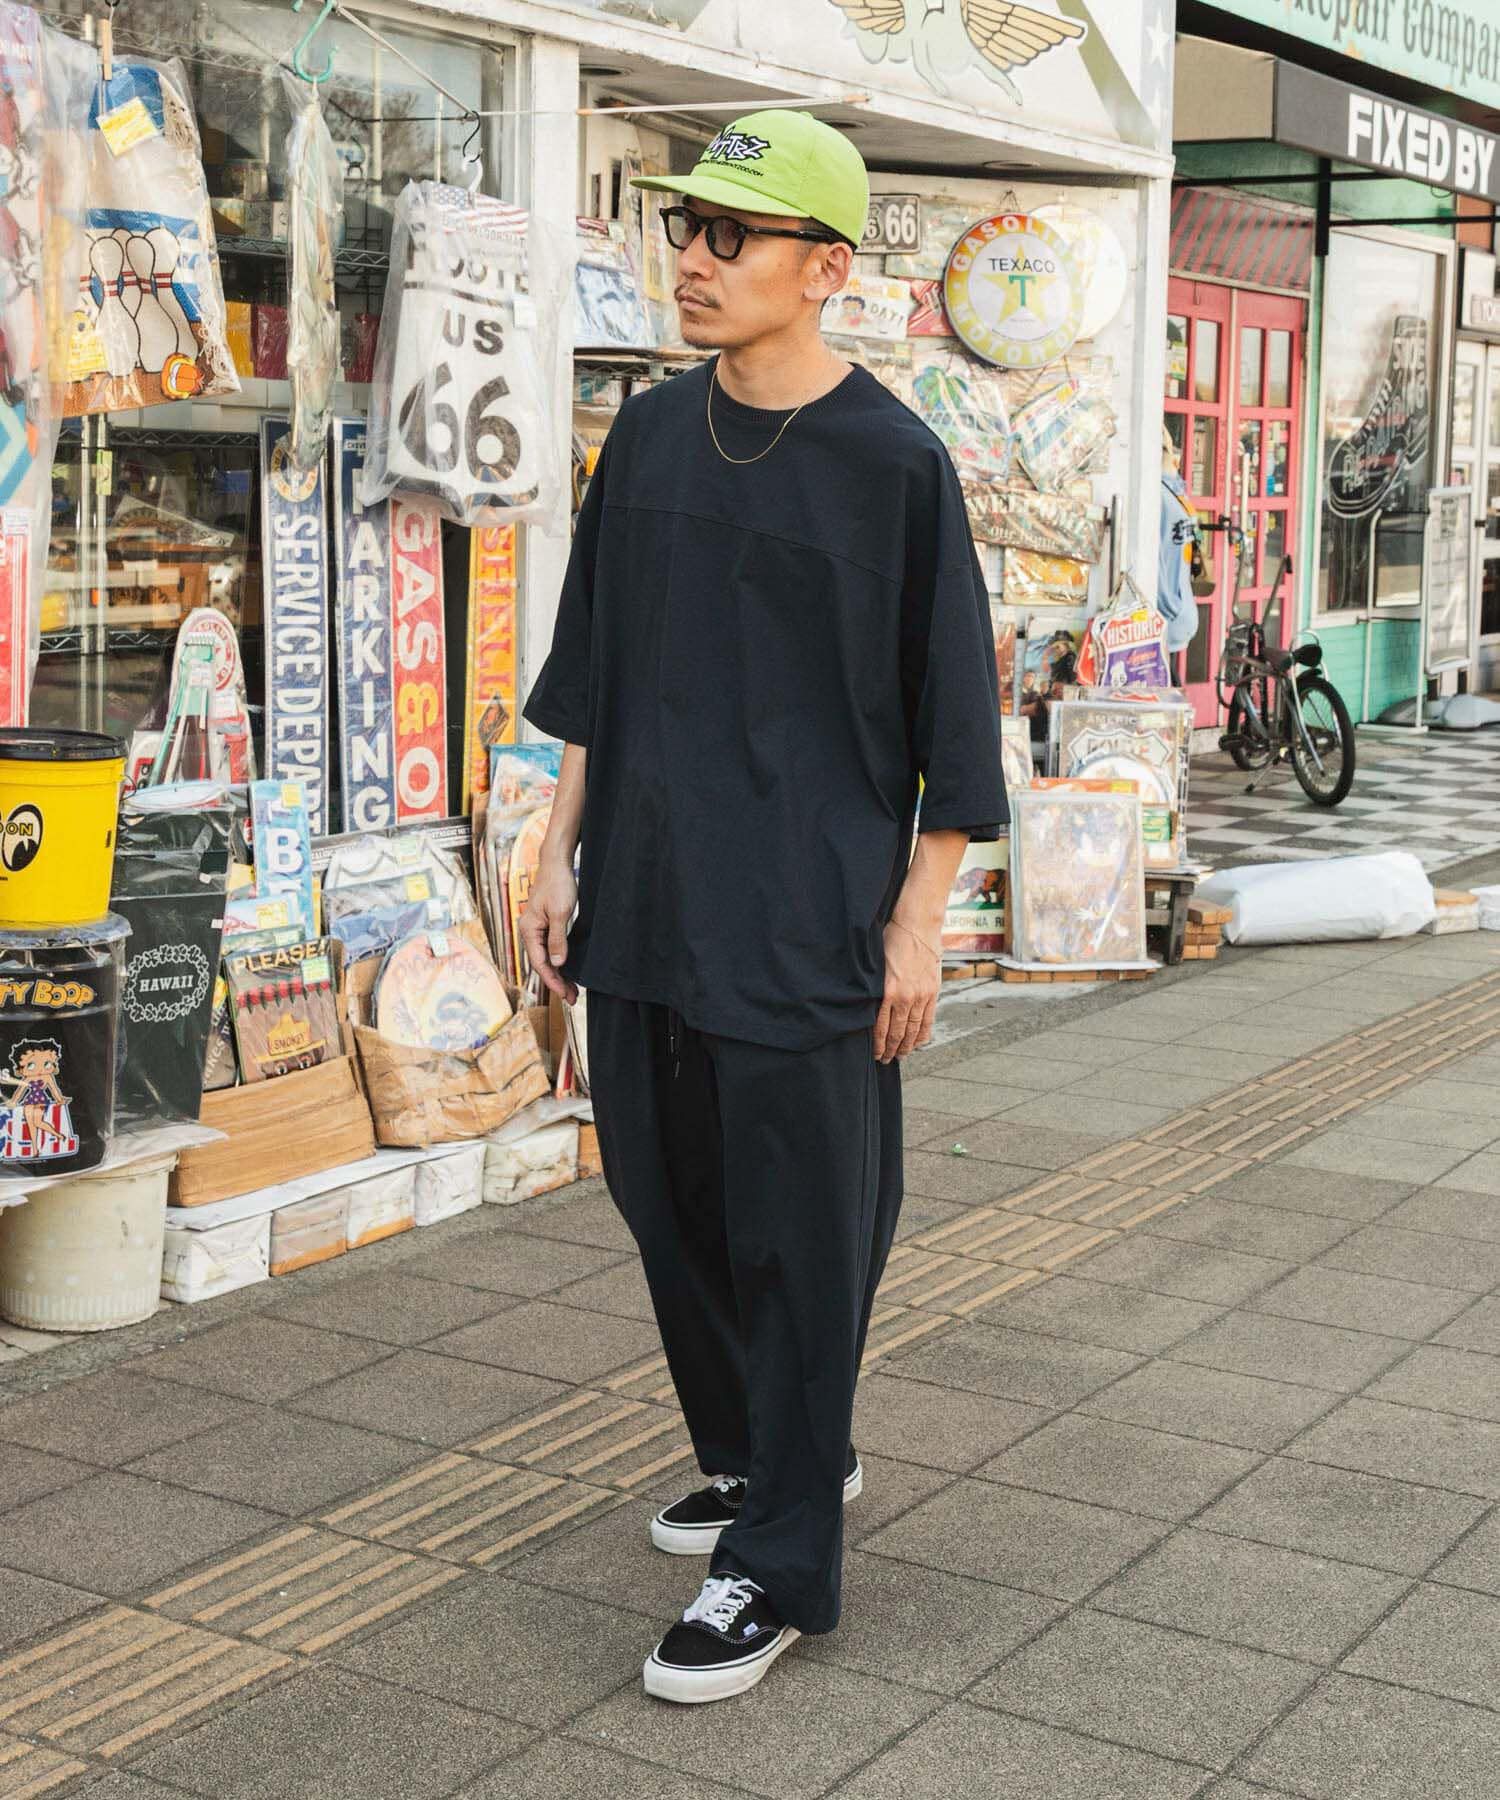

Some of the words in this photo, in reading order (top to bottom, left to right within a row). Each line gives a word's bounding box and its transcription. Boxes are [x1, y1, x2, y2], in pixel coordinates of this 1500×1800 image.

[1402, 0, 1500, 86] Compa
[1347, 93, 1451, 182] FIXED
[1454, 127, 1497, 195] BY
[885, 203, 917, 244] 66
[988, 256, 1056, 274] TEXACO
[1008, 274, 1037, 307] T
[442, 308, 504, 355] US
[398, 361, 521, 484] 66
[273, 514, 322, 677] SERVICE
[395, 503, 439, 671] GAS
[348, 467, 393, 831] ARKING
[1107, 615, 1162, 647] HISTORIC
[231, 938, 331, 976] PLEASE!
[32, 978, 97, 1009] BOOP
[139, 974, 195, 993] HAWAII
